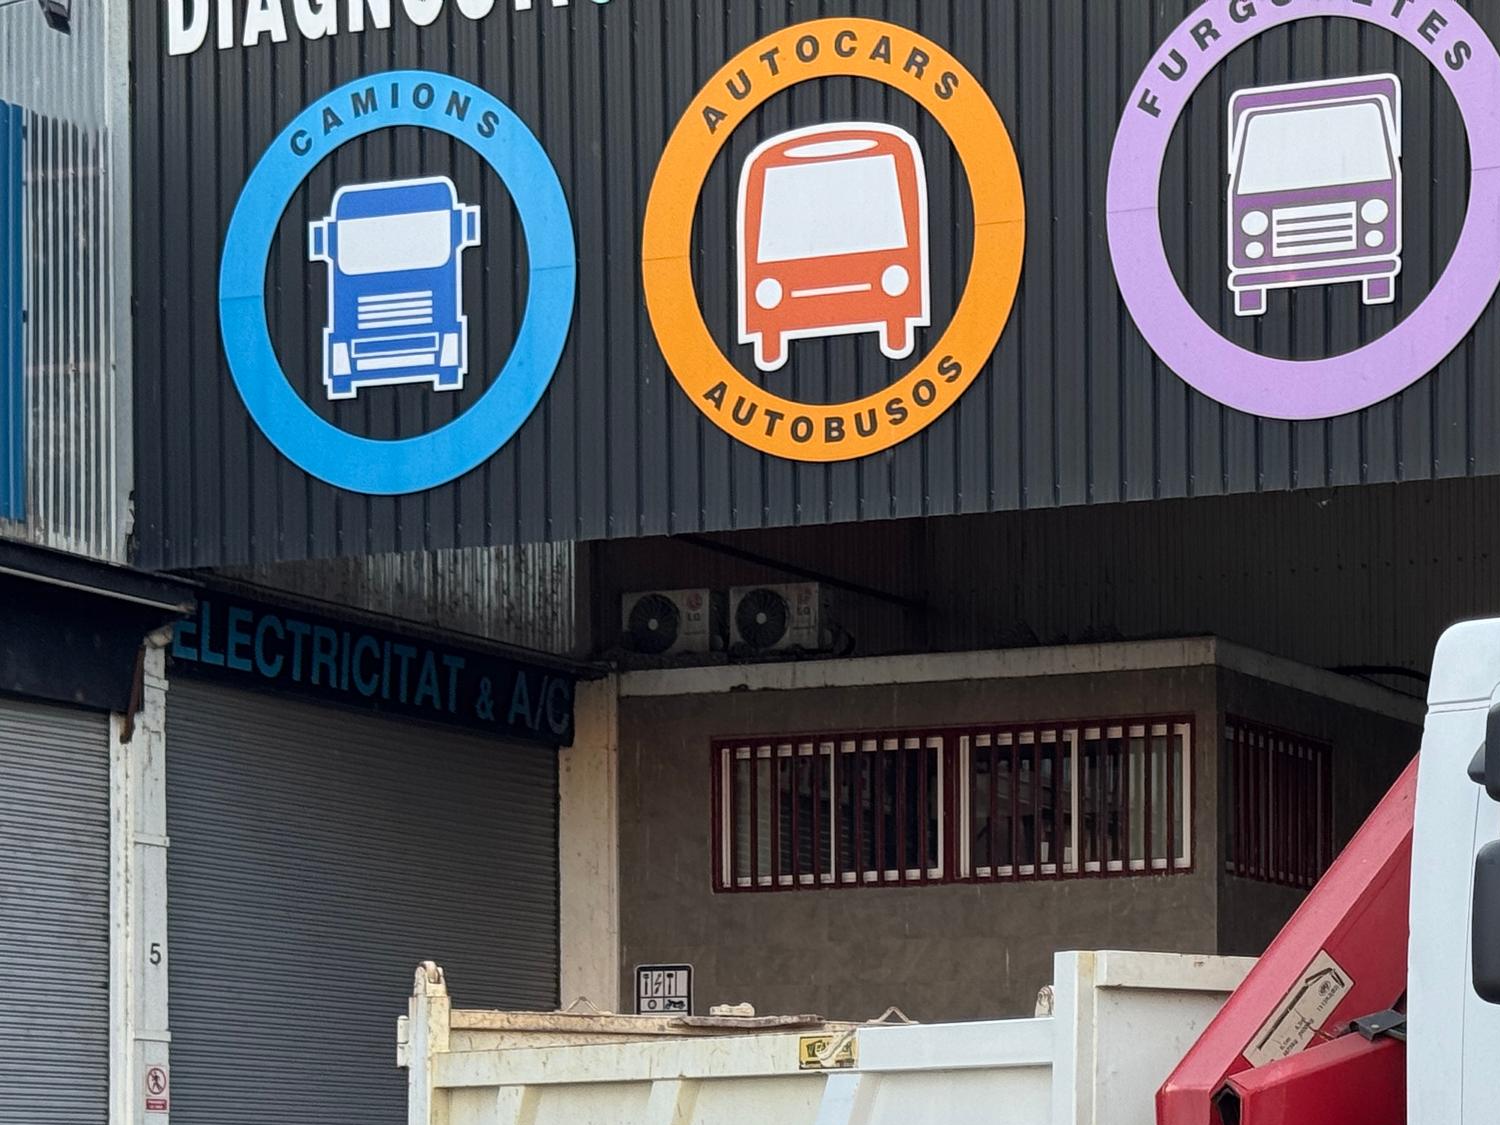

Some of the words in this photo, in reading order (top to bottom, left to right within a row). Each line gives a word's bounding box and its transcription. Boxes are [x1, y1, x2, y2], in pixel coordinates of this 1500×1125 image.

[290, 83, 499, 156] CAMIONS
[703, 30, 959, 135] AUTOCARS
[703, 355, 963, 444] AUTOBUSOS
[172, 601, 465, 713] ELECTRICITAT
[475, 676, 495, 722] &
[507, 670, 570, 735] A/C
[150, 943, 162, 966] 5
